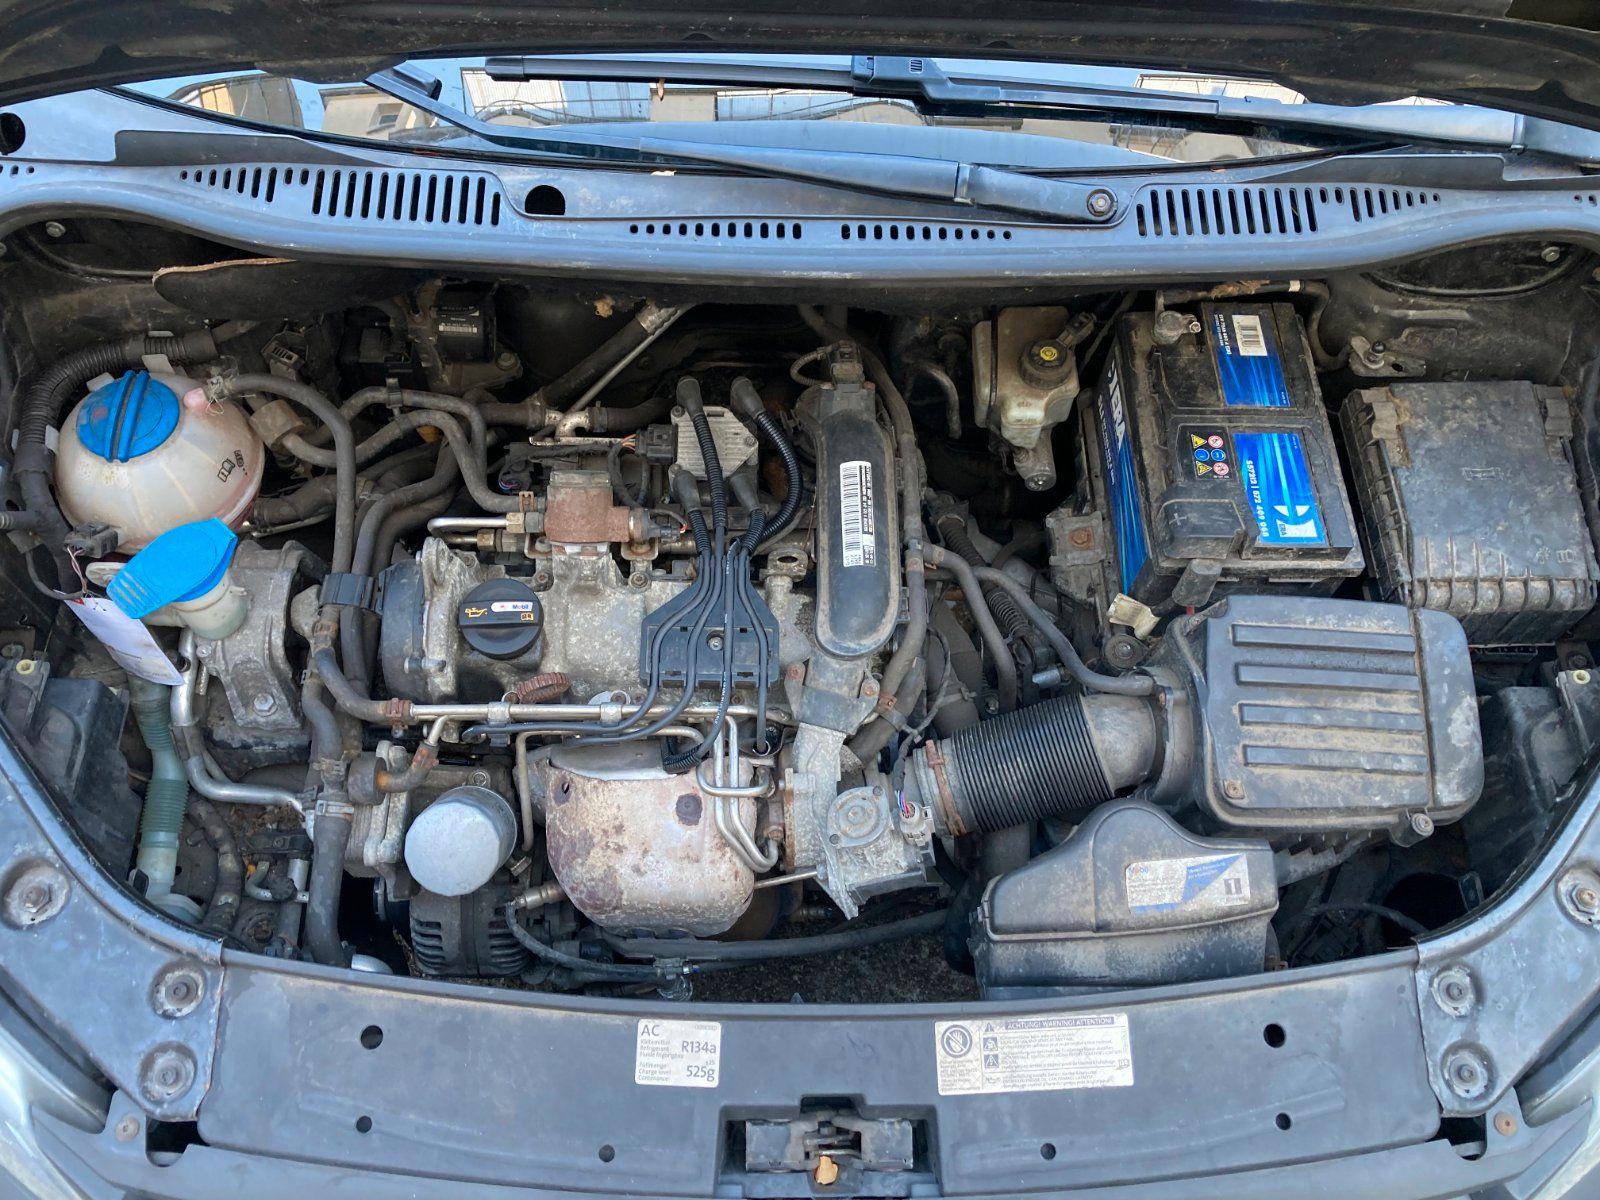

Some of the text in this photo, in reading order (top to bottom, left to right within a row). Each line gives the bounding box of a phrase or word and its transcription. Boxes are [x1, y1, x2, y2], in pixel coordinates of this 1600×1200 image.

[1279, 523, 1288, 536] ERA
[1007, 1017, 1112, 1030] ACHTUNG! WARNING! ATTENTION!
[640, 1024, 660, 1037] AC
[681, 1040, 717, 1054] R134a
[685, 1064, 716, 1082] 525g
